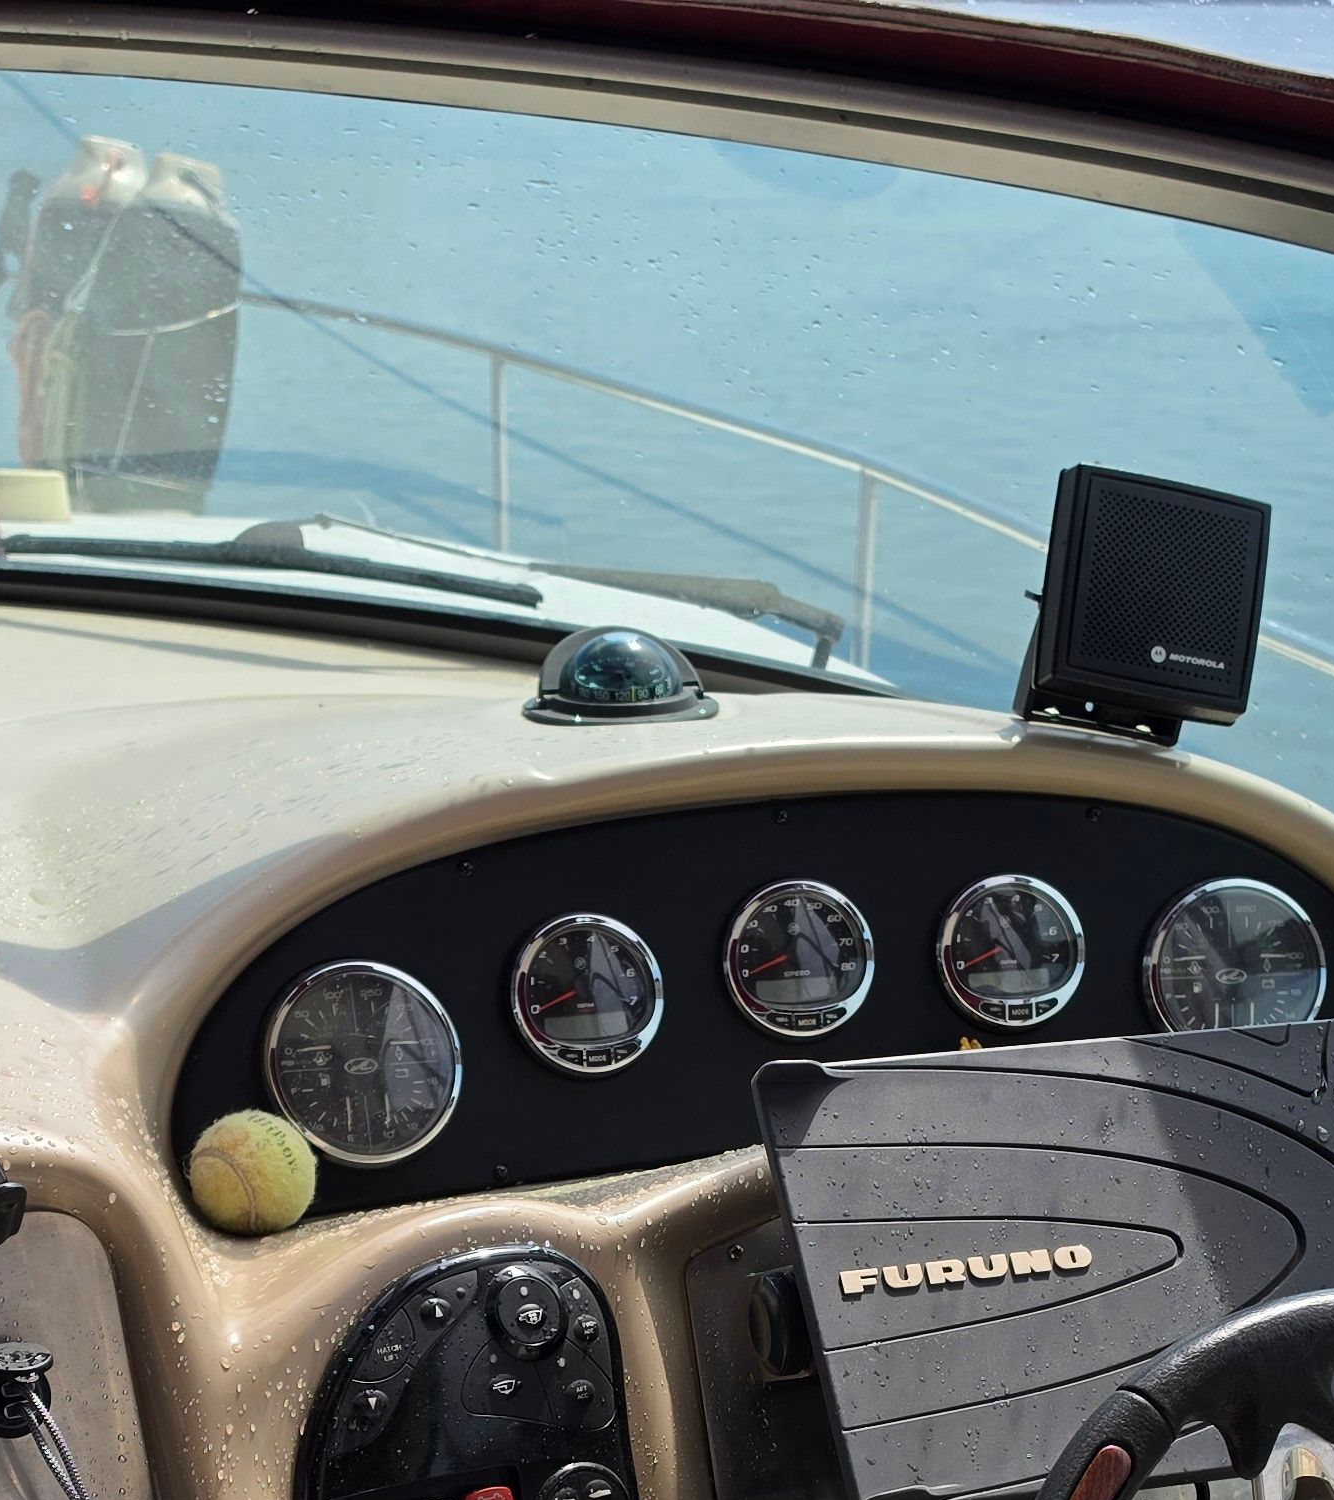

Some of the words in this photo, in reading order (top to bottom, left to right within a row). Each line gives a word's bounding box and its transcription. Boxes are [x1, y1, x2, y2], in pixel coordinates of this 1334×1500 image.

[1169, 652, 1225, 670] MOTOROLA
[594, 690, 608, 700] 150
[615, 690, 630, 700] 120
[638, 689, 649, 699] 90
[655, 684, 664, 694] 60
[783, 899, 800, 907] 40
[807, 902, 823, 910] 50
[827, 914, 843, 923] 60
[1049, 926, 1058, 936] 6
[839, 937, 854, 947] 70
[1050, 954, 1060, 963] 7
[841, 962, 856, 971] 80
[626, 968, 635, 977] 6
[629, 996, 638, 1006] 7
[531, 1004, 540, 1015] 0
[798, 1018, 817, 1026] MODE
[588, 1054, 607, 1063] MODE
[839, 1244, 1093, 1295] FURUNO
[376, 1344, 402, 1354] HATCH
[383, 1353, 399, 1362] LIFT
